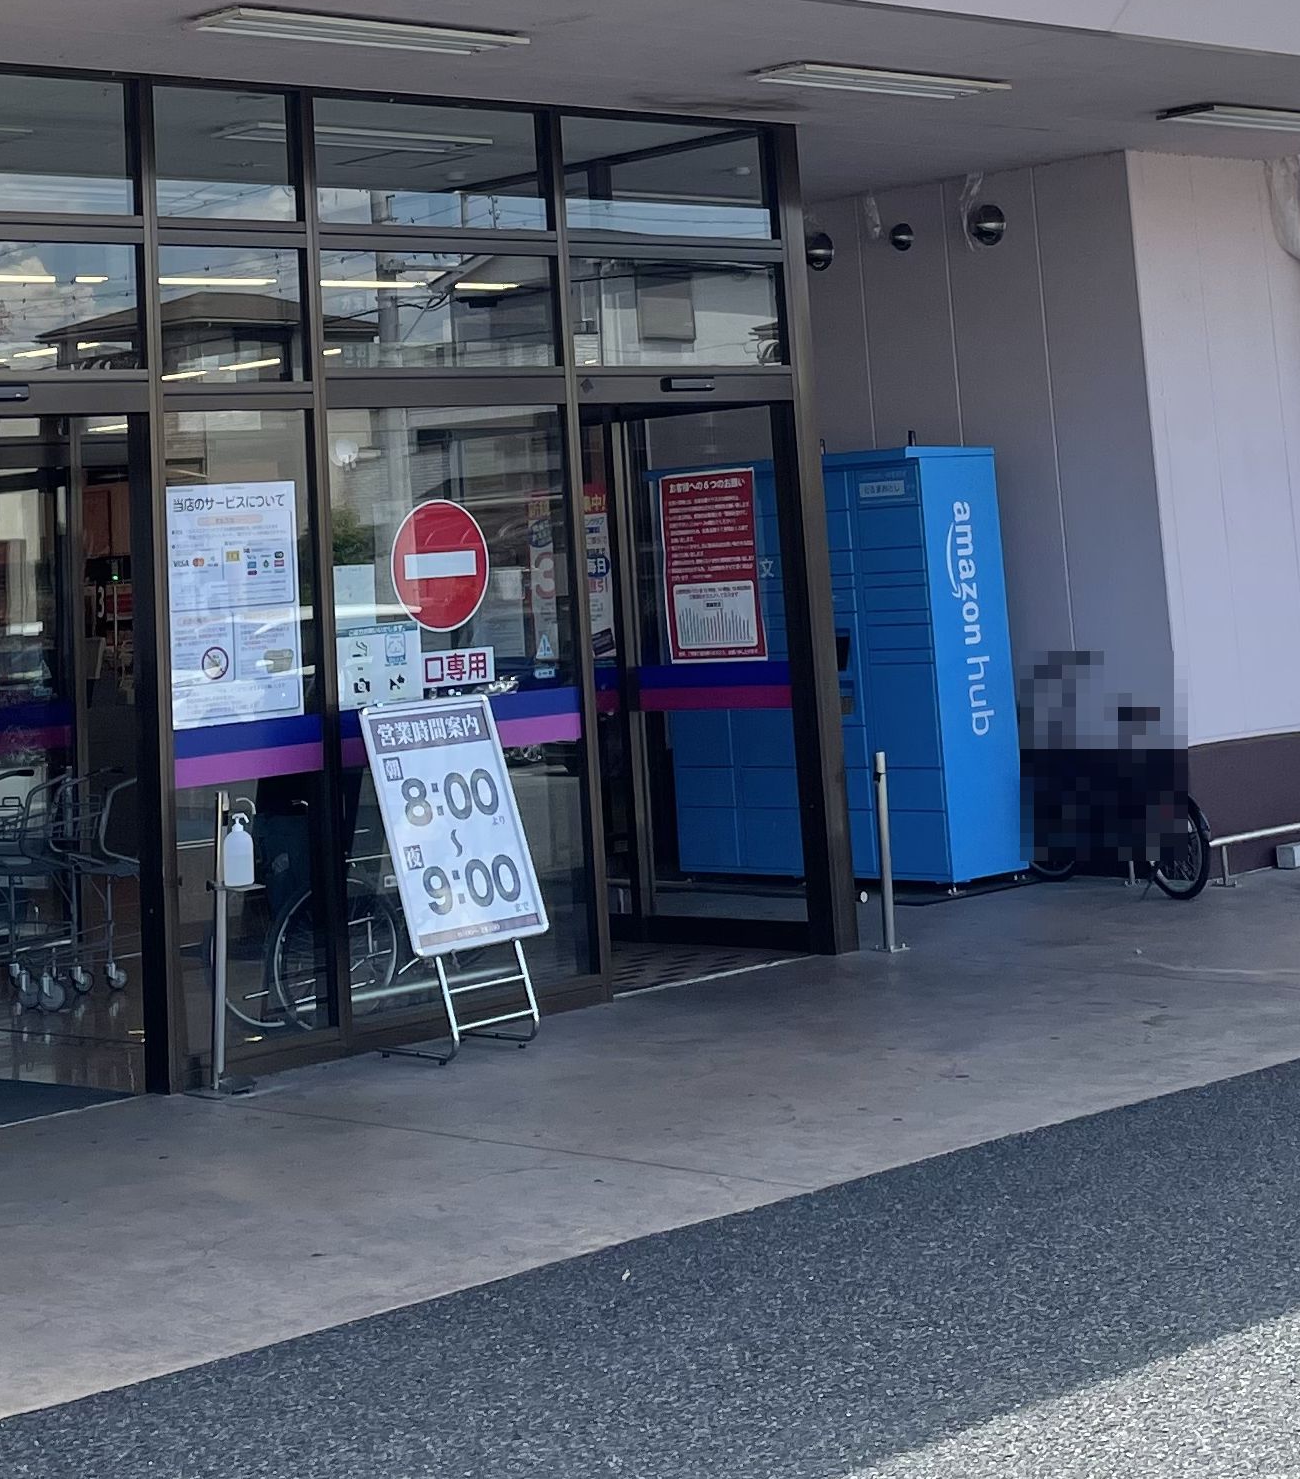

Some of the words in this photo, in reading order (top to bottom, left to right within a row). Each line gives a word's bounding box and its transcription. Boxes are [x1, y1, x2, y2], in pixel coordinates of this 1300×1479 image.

[173, 494, 285, 513] 当店のサービスについて
[951, 501, 983, 646] amazon
[966, 656, 996, 736] hub
[377, 714, 480, 746] 営業時間案内
[385, 760, 401, 780] 朝
[401, 768, 499, 827] 8:00
[405, 847, 422, 868] 夜
[422, 854, 521, 916] 9:00
